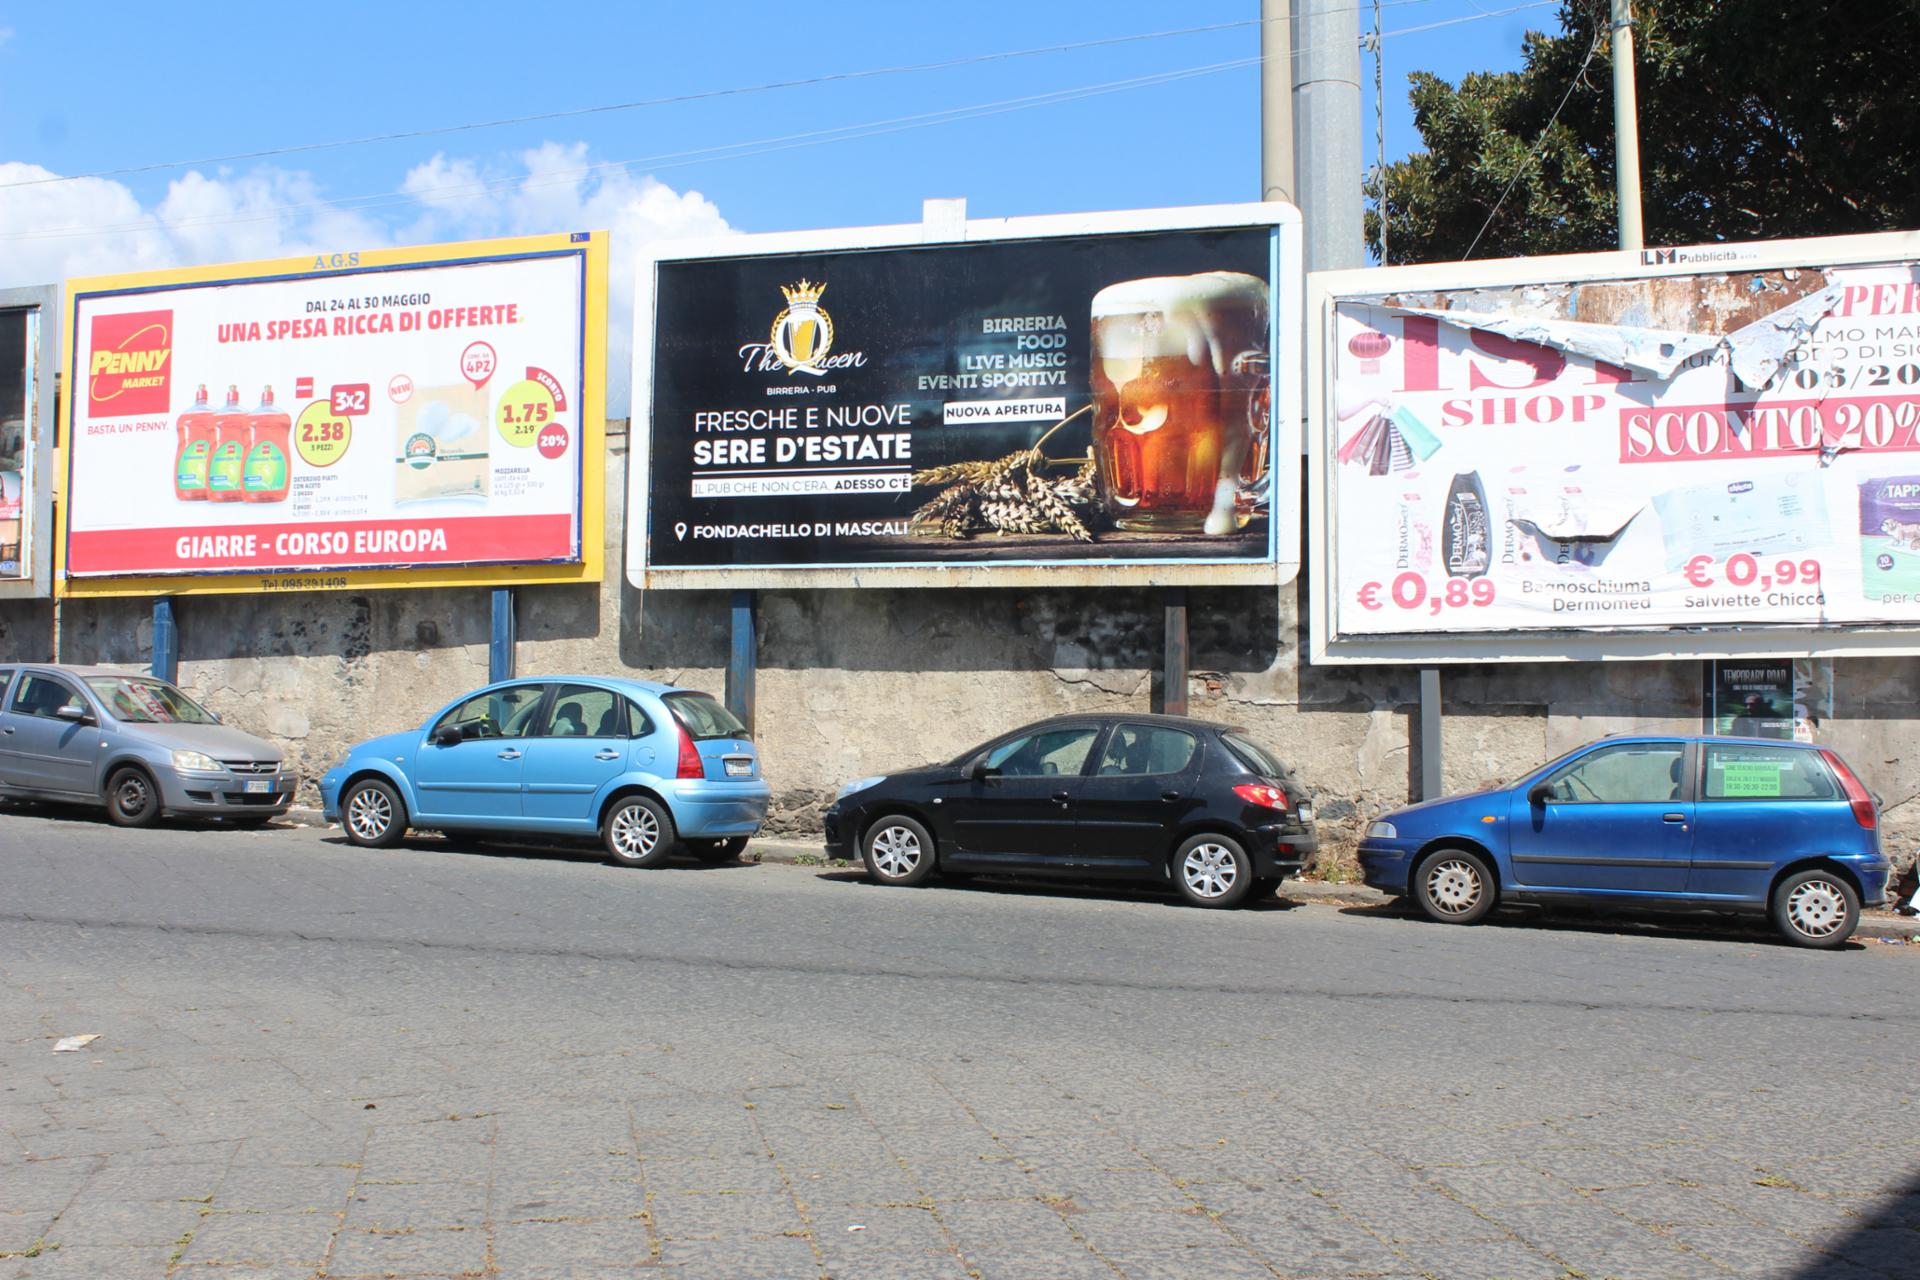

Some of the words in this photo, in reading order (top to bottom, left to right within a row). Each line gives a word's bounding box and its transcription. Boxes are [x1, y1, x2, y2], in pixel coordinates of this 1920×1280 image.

[314, 252, 360, 270] A.G.S
[1680, 252, 1736, 263] Pubblicità
[306, 301, 326, 313] DAL
[330, 300, 344, 311] 24
[348, 299, 361, 310] AL
[364, 297, 378, 308] 30
[382, 293, 430, 307] MAGGIO
[1824, 282, 1920, 317] PER
[218, 322, 261, 344] UNA
[266, 318, 327, 340] SPESA
[333, 313, 394, 336] RICCA
[400, 311, 421, 331] DI
[982, 315, 1067, 334] BIRRERIA
[1017, 334, 1066, 350] FOOD
[738, 343, 783, 373] The
[1392, 315, 1647, 392] IS
[1859, 345, 1882, 358] DI
[90, 348, 170, 376] PENNY
[466, 360, 490, 373] 4PZ
[966, 354, 1004, 370] LIVE
[1008, 352, 1067, 368] MUSIC
[122, 376, 165, 388] MARKET
[536, 372, 563, 402] SCONTO
[918, 374, 978, 390] EVENTI
[981, 370, 1066, 388] SPORTIVI
[390, 383, 410, 396] NEW
[767, 386, 809, 396] BIRRERIA
[816, 385, 836, 394] PUB
[335, 391, 366, 412] 3x2
[946, 406, 991, 418] NUOVA
[994, 403, 1062, 416] APERTURA
[503, 402, 548, 423] 1.75
[695, 408, 798, 432] FRESCHE
[806, 408, 818, 428] E
[827, 404, 912, 428] NUOVE
[1442, 395, 1606, 427] SHOP
[88, 424, 116, 436] BASTA
[119, 423, 133, 433] UN
[136, 420, 169, 432] PENNY.
[302, 422, 344, 442] 2.38
[515, 425, 534, 434] 2.19
[1628, 405, 1824, 457] SCONTO
[1834, 401, 1920, 449] 20%
[540, 434, 566, 448] 20%
[693, 438, 766, 466] SERE
[776, 433, 912, 463] D'ESTATE
[694, 483, 704, 494] IL
[707, 482, 731, 493] PUB
[734, 481, 758, 492] CHE
[762, 480, 790, 492] NON
[834, 478, 886, 490] ADESSO
[693, 522, 811, 538] FONDACHELLO
[814, 522, 831, 537] DI
[835, 521, 908, 536] MASCALI
[176, 534, 257, 559] GIARRE
[276, 532, 348, 556] CORSO
[354, 528, 447, 554] EUROPA
[1683, 555, 1714, 588] €
[1725, 553, 1821, 592] 0,99
[1356, 581, 1384, 611] €
[1391, 571, 1496, 616] 0,89
[1684, 594, 1761, 608] Salviette
[1882, 594, 1908, 605] per
[1553, 598, 1651, 612] Dermomed
[1723, 669, 1765, 682] TEMPORARY
[1766, 668, 1786, 681] ROAD
